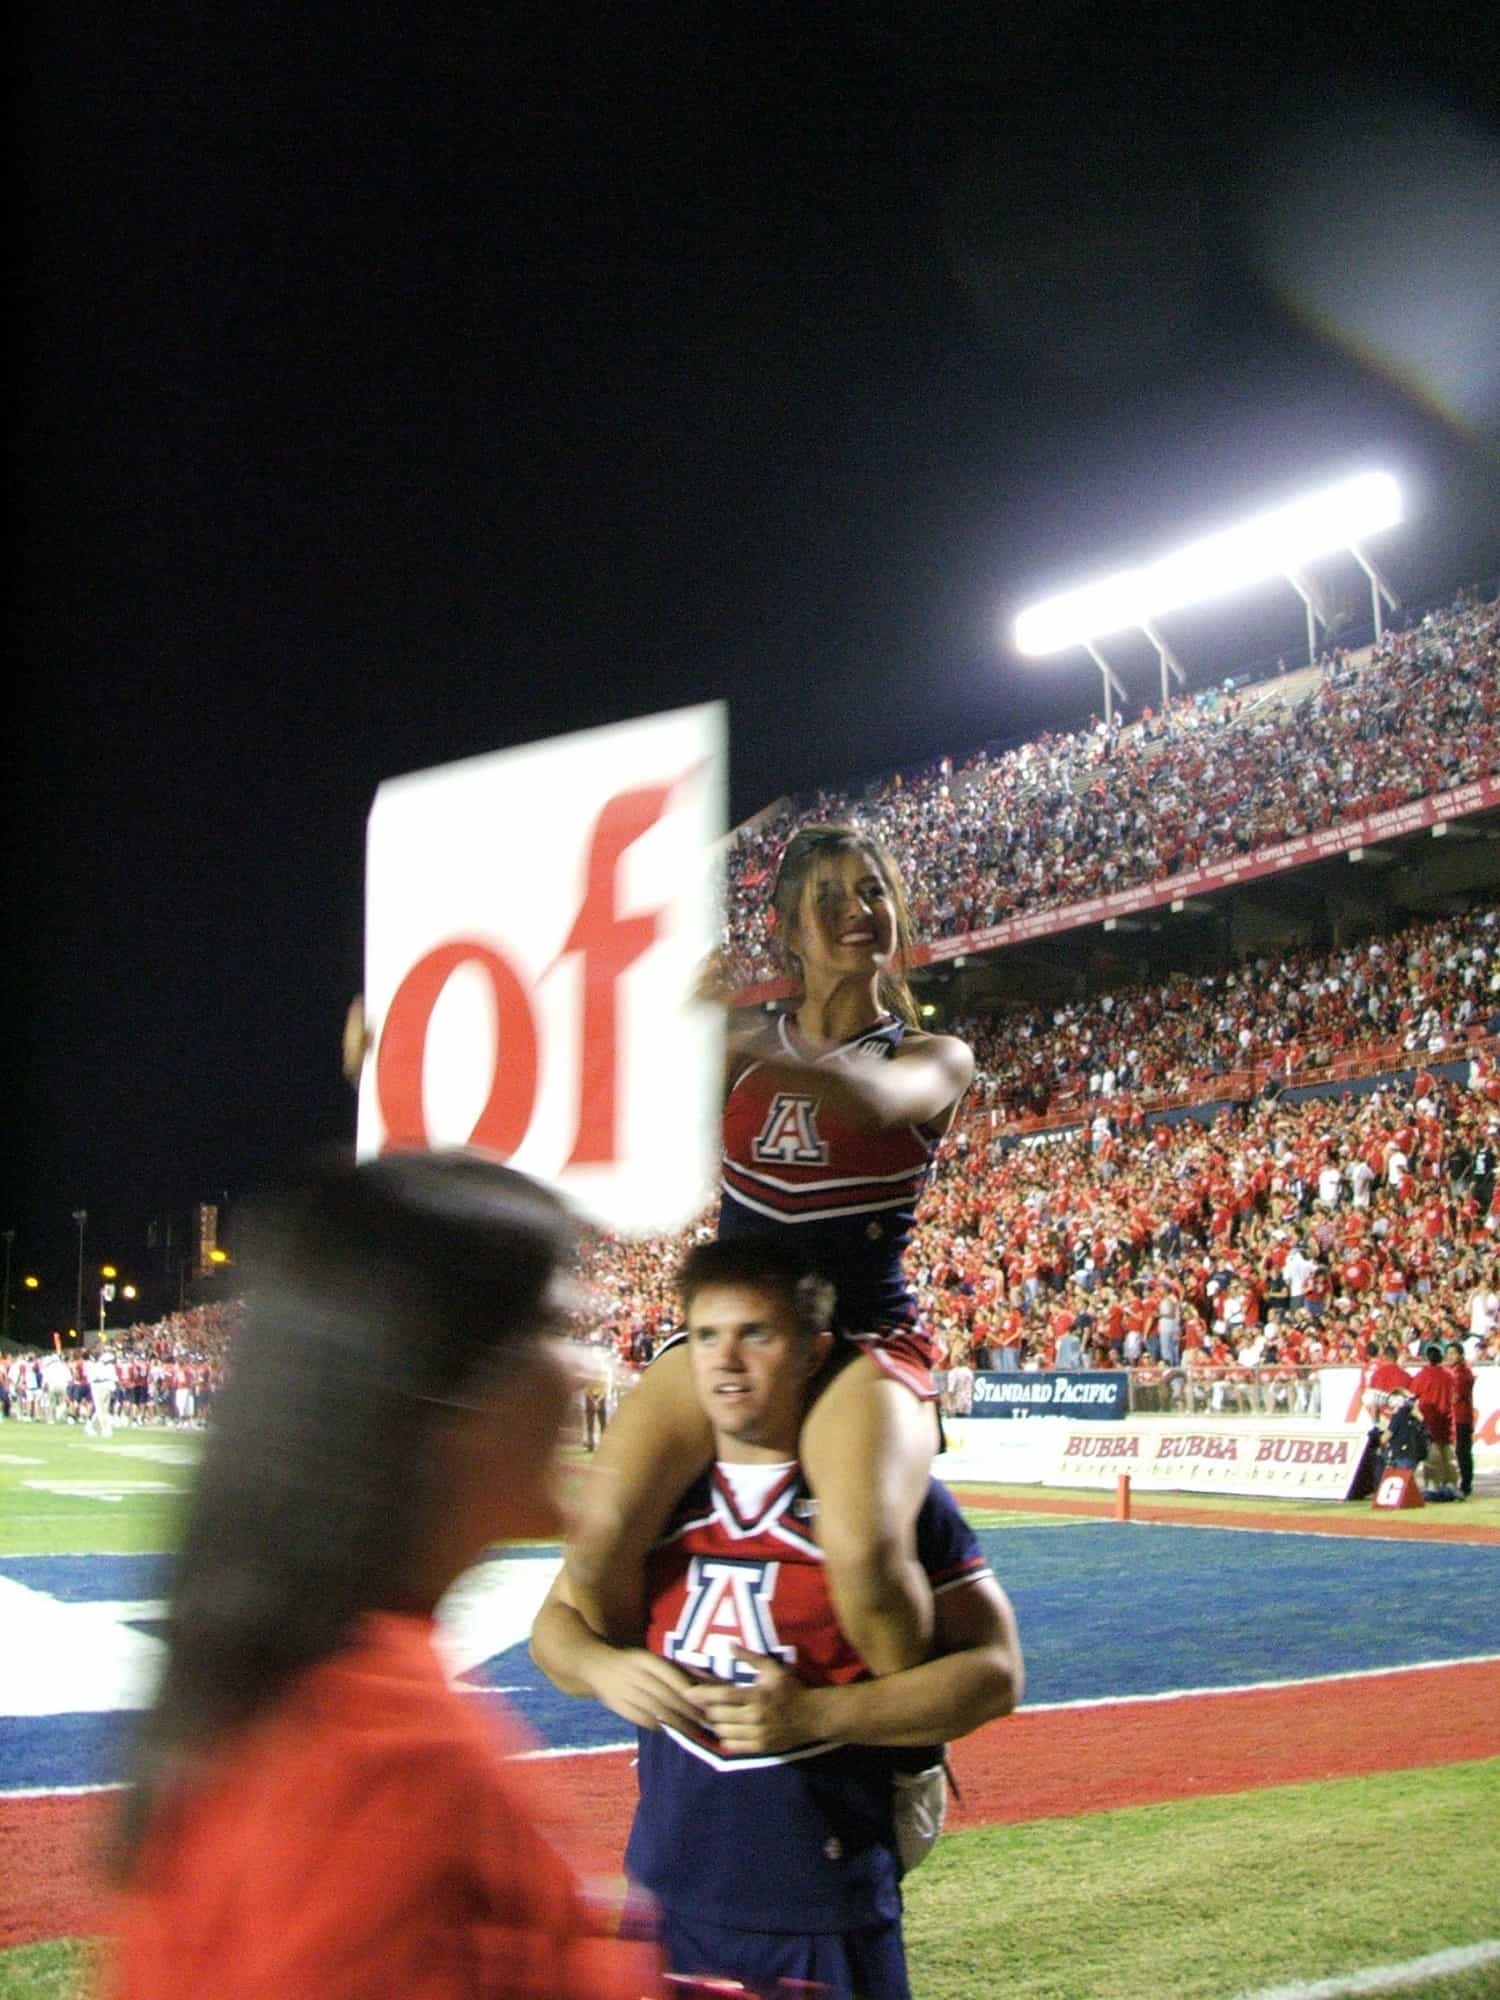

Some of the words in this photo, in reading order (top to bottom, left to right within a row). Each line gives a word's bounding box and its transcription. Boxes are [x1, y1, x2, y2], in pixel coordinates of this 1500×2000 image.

[376, 762, 706, 1172] of
[753, 1092, 828, 1165] A
[974, 1376, 1052, 1402] STANDARD
[1052, 1377, 1117, 1403] PACIFIC
[1064, 1435, 1140, 1458] BUBBA
[1155, 1435, 1238, 1460] BUBBA
[1255, 1438, 1349, 1464] BUBBA
[1376, 1475, 1405, 1506] G
[664, 1556, 796, 1687] A
